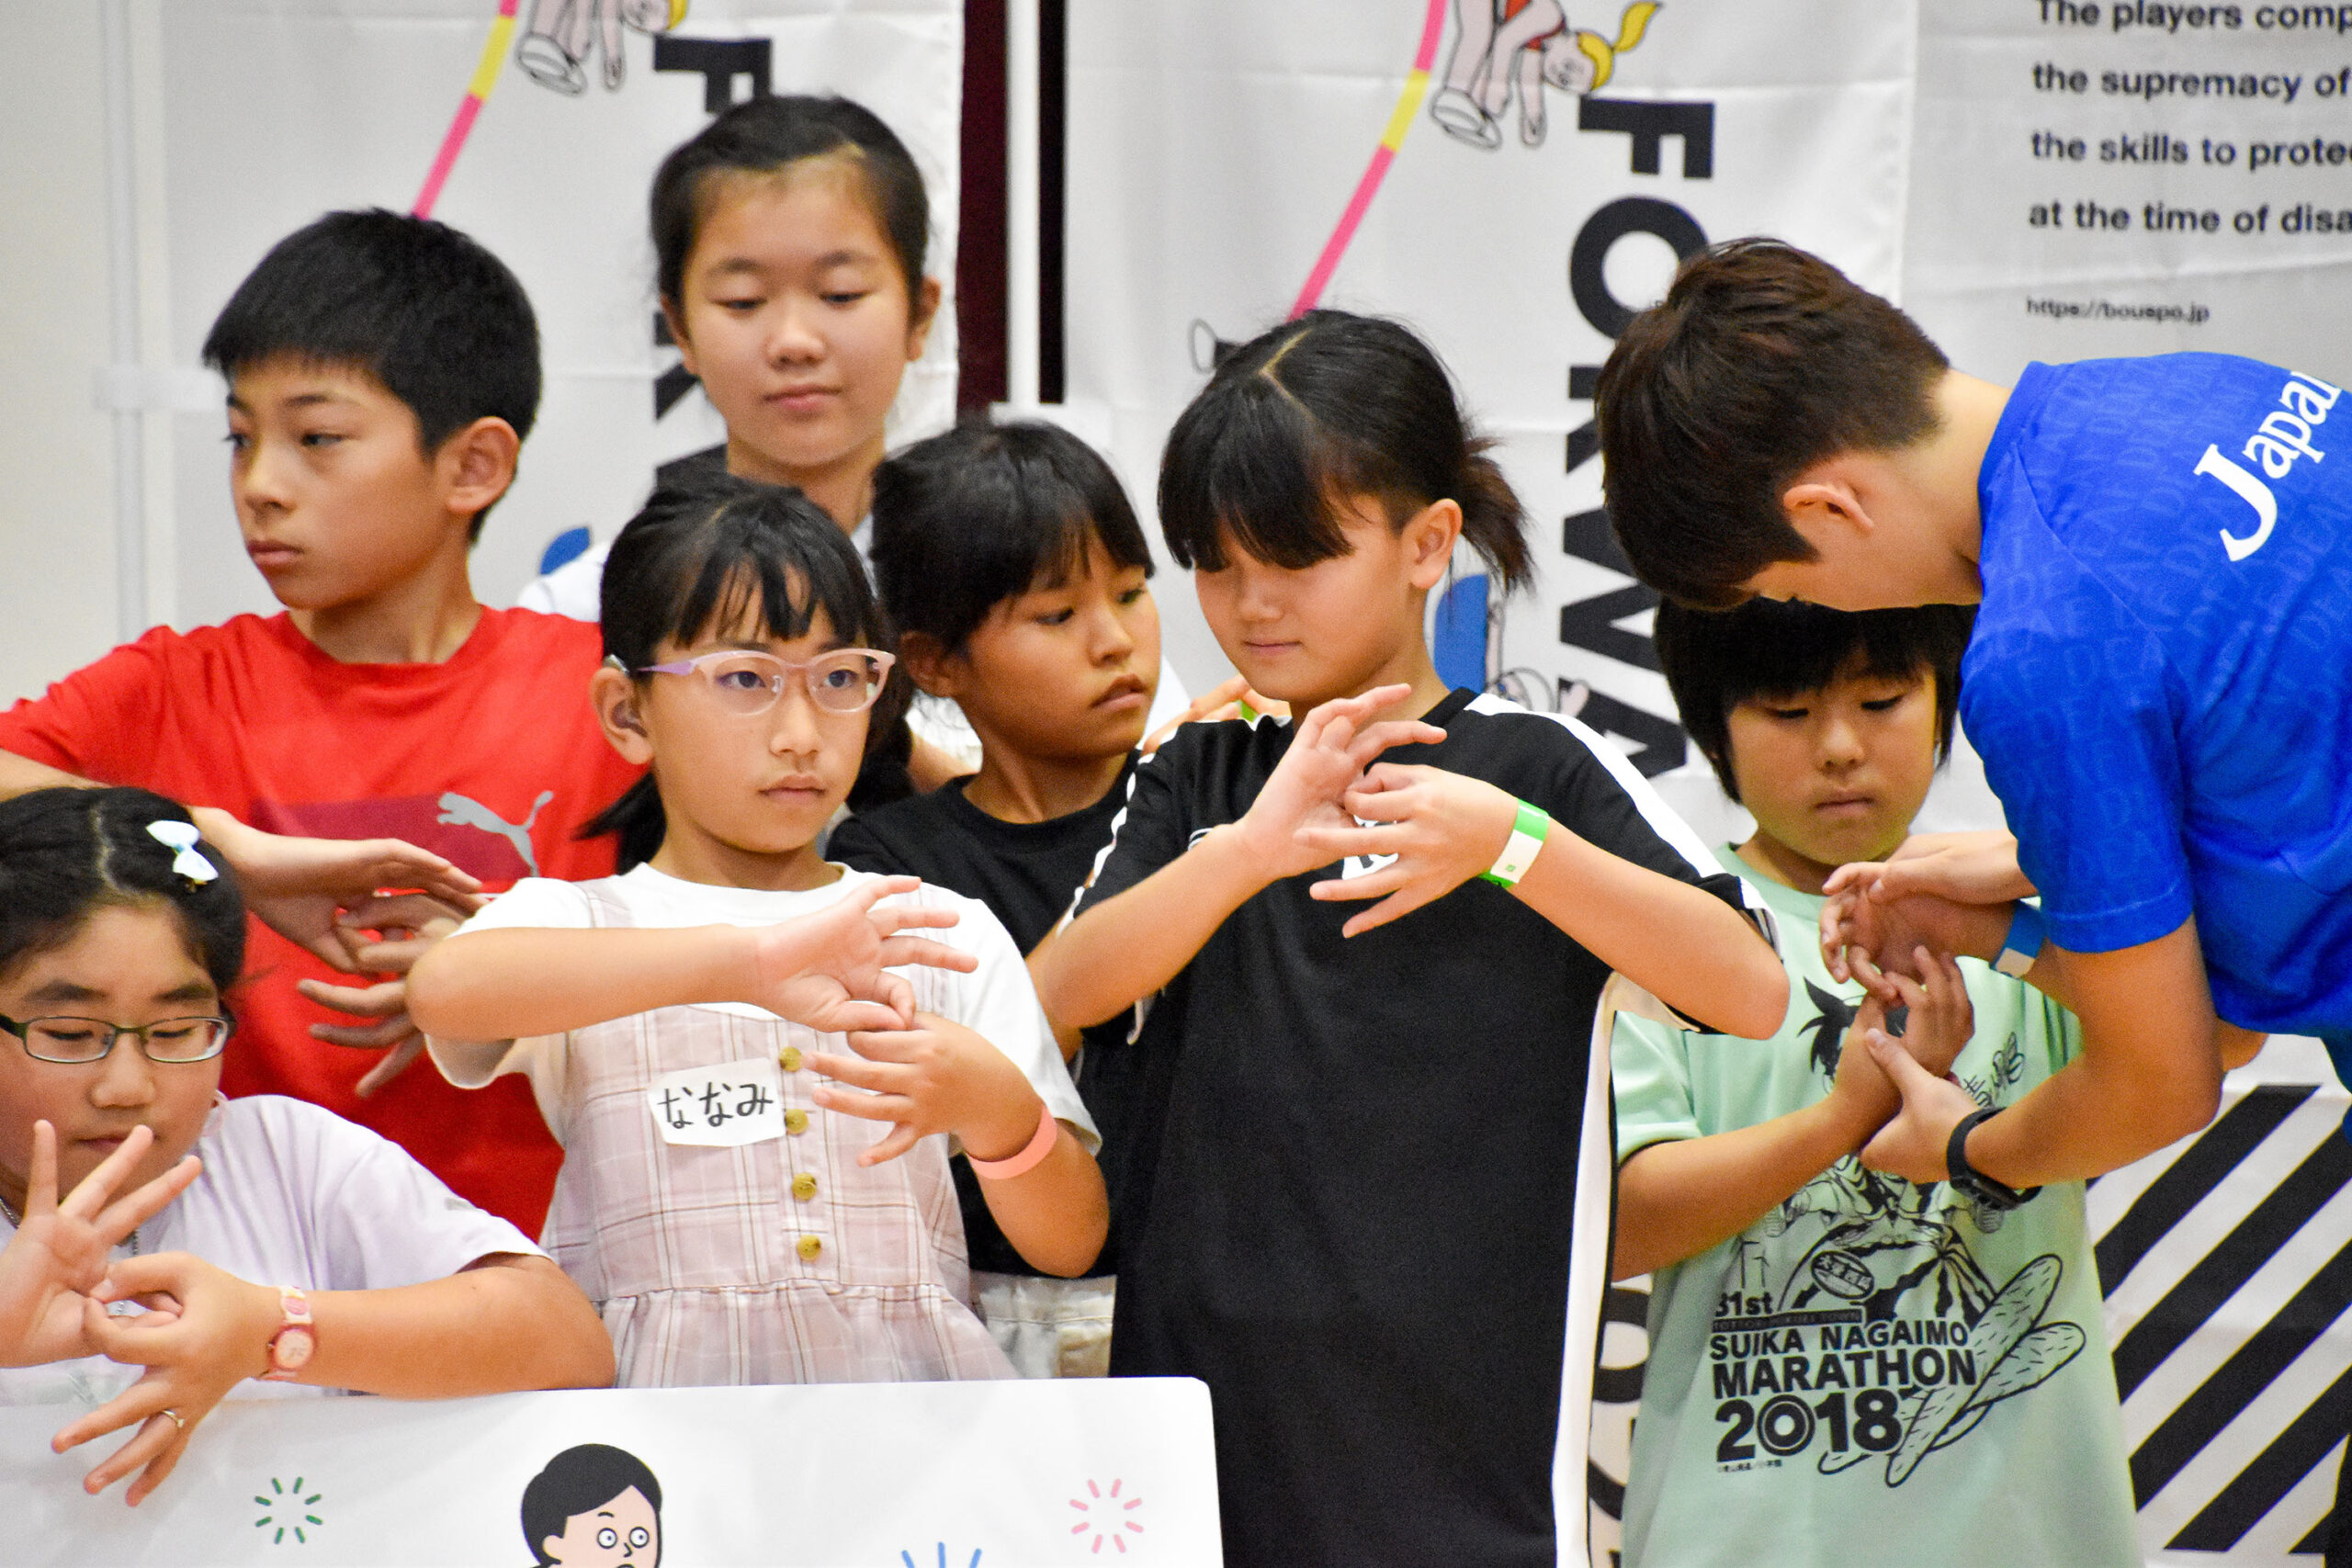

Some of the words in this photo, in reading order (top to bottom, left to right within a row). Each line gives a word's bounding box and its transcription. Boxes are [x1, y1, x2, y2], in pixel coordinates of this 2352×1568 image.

[2113, 0, 2242, 34] players
[2032, 62, 2088, 94] the
[2101, 70, 2301, 103] supremacy
[2314, 67, 2351, 97] of
[2031, 131, 2086, 162] the
[2099, 132, 2188, 164] skills
[2202, 137, 2236, 165] to
[2249, 136, 2352, 173] prote
[2029, 199, 2062, 228] at
[2075, 199, 2131, 230] the
[2143, 199, 2221, 232] time
[2233, 202, 2270, 233] of
[657, 1081, 774, 1129] ななみ
[1710, 1328, 1805, 1360] SUIKA
[1820, 1319, 1969, 1351] NAGAIMO
[1713, 1348, 1976, 1400] MARATHON
[1715, 1388, 1903, 1462] 2018
